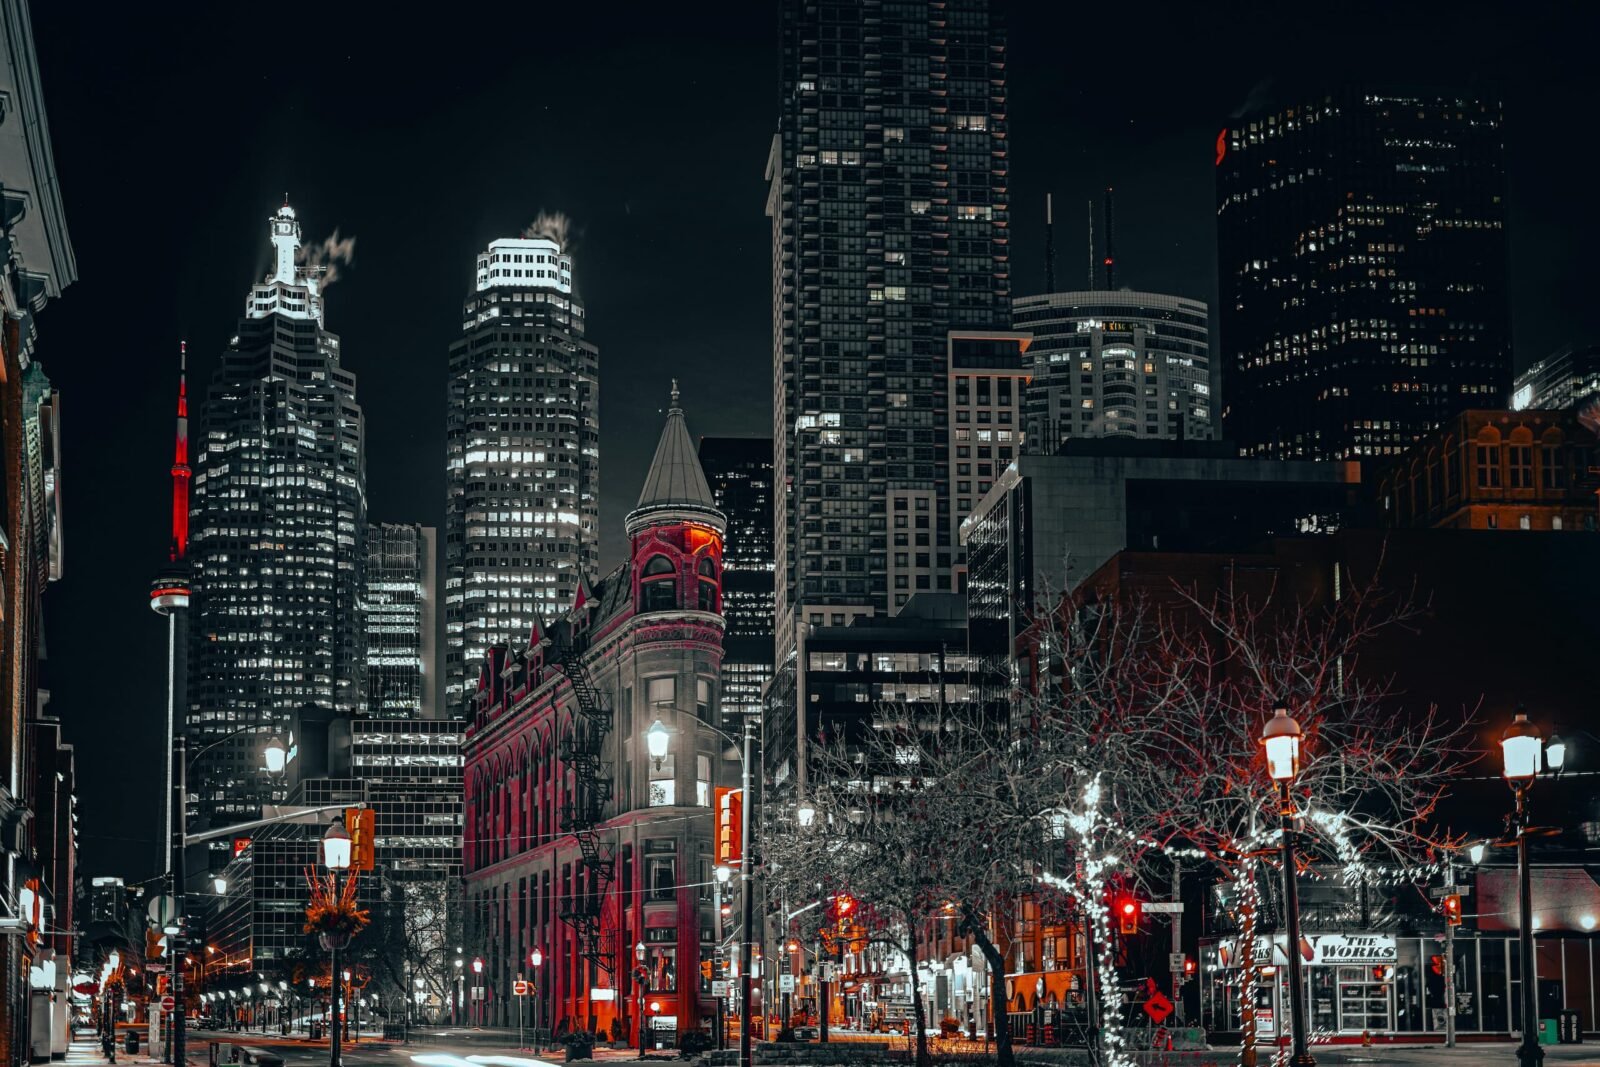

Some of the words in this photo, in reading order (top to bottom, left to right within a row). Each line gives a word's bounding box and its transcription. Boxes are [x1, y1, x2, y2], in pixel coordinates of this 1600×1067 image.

[277, 223, 292, 233] TD
[1345, 936, 1378, 947] THE
[1322, 944, 1397, 958] WORKS
